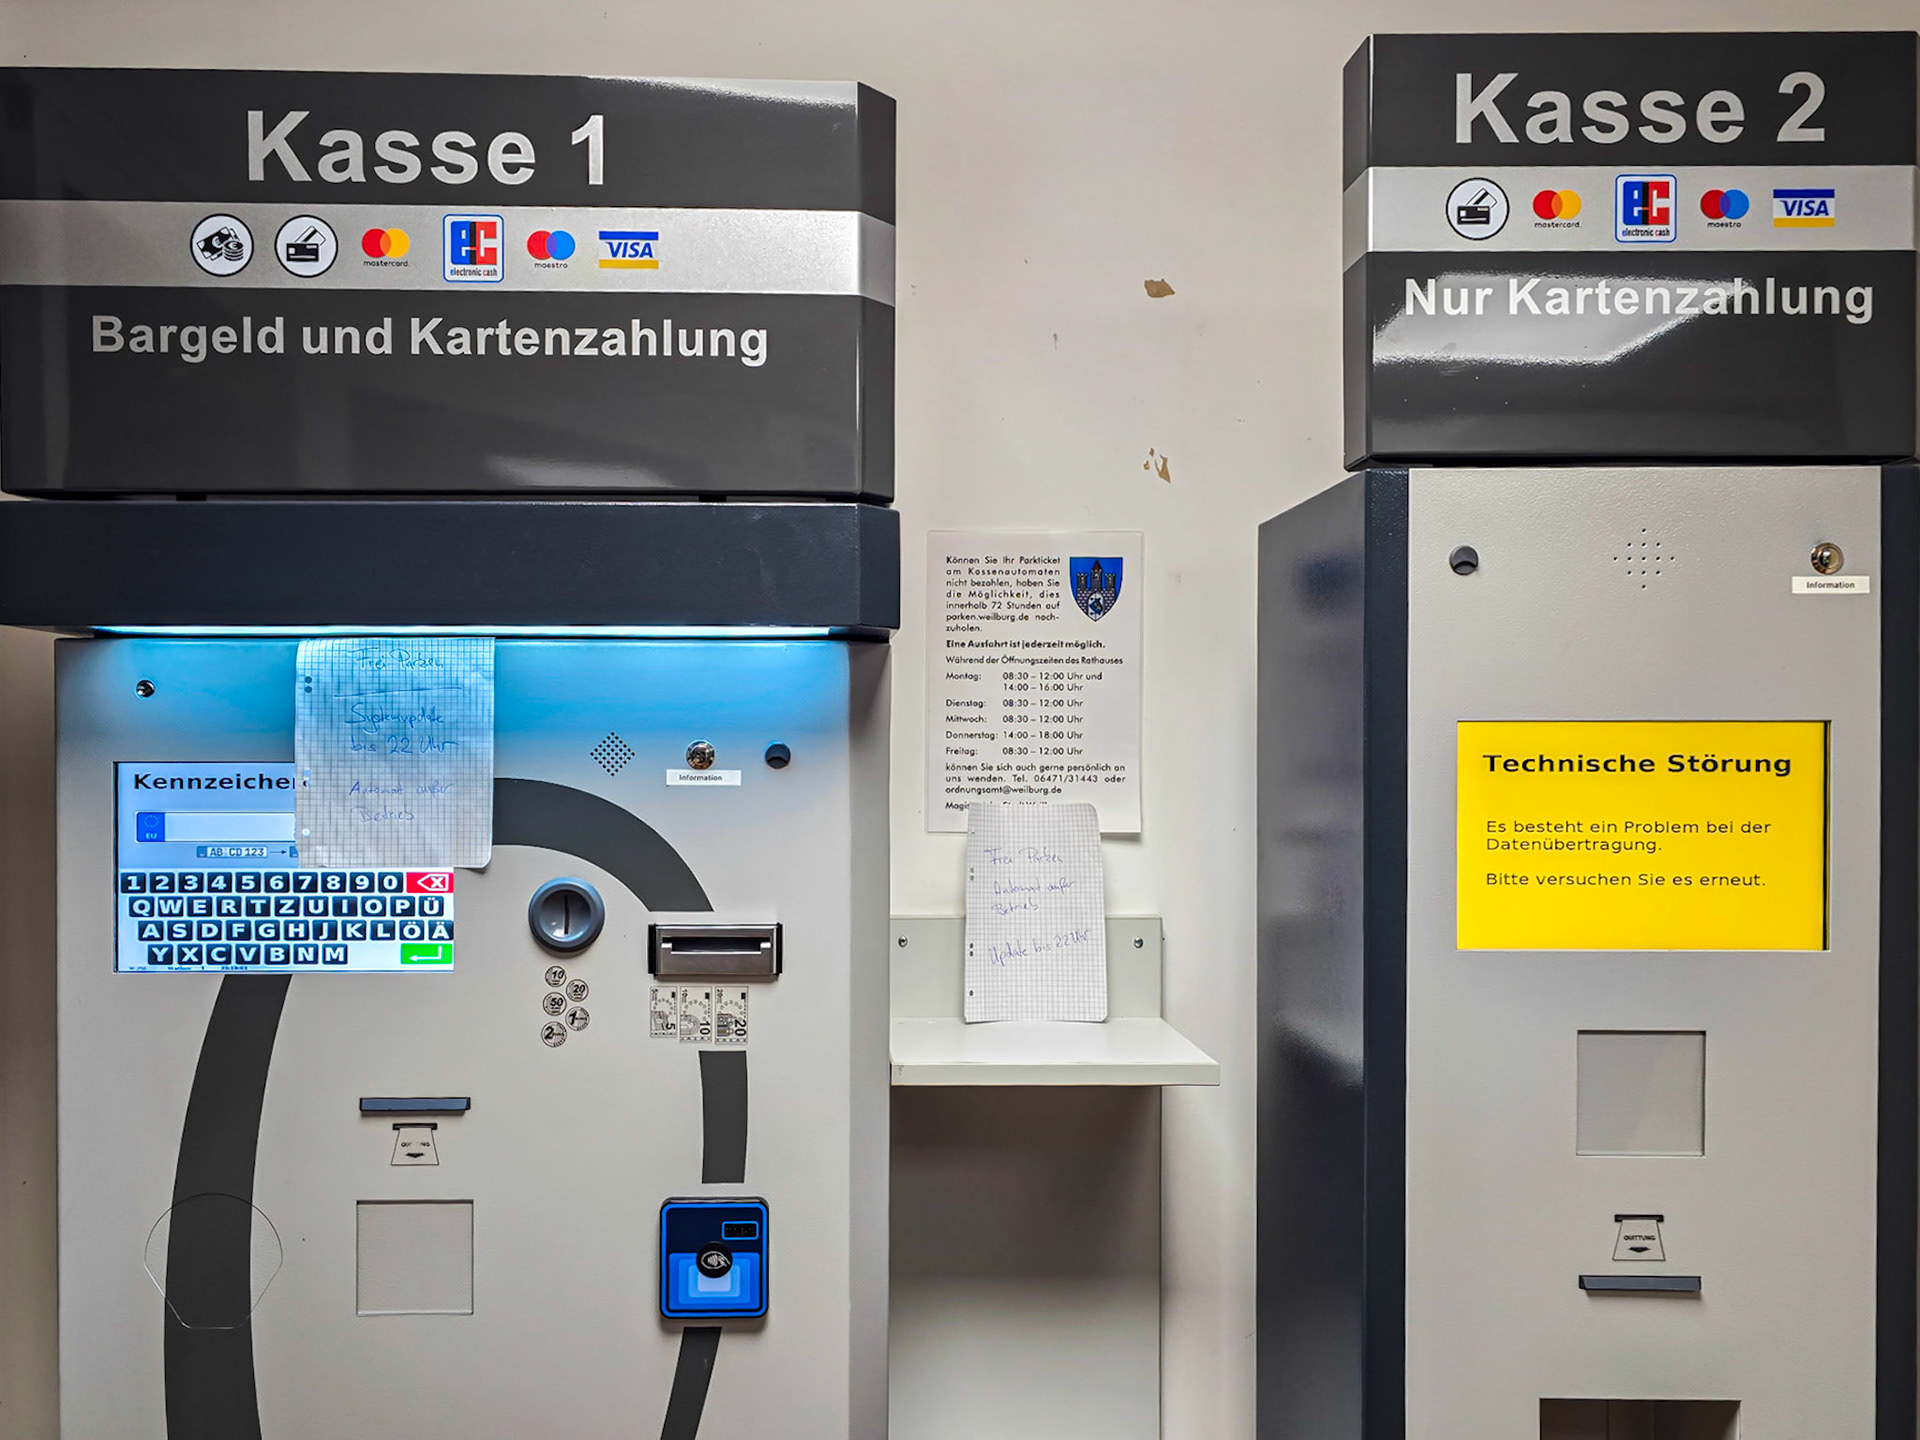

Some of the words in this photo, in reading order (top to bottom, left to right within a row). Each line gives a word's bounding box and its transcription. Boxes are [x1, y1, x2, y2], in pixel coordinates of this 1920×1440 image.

[1455, 72, 1746, 144] Kasse
[1777, 71, 1826, 143] 2
[246, 110, 537, 185] Kasse
[571, 114, 606, 186] 1
[1780, 200, 1829, 216] VISA
[1707, 220, 1741, 229] maestro
[1622, 228, 1654, 237] electronic
[1655, 228, 1670, 237] cash
[605, 242, 653, 258] VISA
[450, 267, 481, 277] electronic
[483, 268, 497, 277] cash
[1405, 278, 1492, 316] Nur
[1508, 277, 1874, 325] Kartenzahlung
[92, 314, 285, 364] Bargeld
[302, 317, 393, 356] und
[410, 317, 769, 368] Kartenzahlung
[946, 556, 979, 564] Können
[985, 556, 997, 564] Sie
[1020, 556, 1060, 564] Parkticket
[968, 567, 1060, 575] Kassenautomaten
[971, 578, 1012, 588] bezahlen,
[1016, 579, 1043, 587] haben
[1047, 579, 1060, 587] Sie
[1806, 580, 1855, 589] Information
[946, 590, 962, 598] die
[968, 590, 1032, 600] Möglichkeit,
[1039, 590, 1060, 598] dies
[946, 601, 987, 609] innerhalb
[991, 601, 1002, 609] 72
[1007, 601, 1041, 609] Stunden
[1046, 601, 1060, 609] auf
[946, 613, 1029, 622] parken.weilburg.de
[1035, 613, 1059, 621] nach-
[946, 624, 982, 632] zuholen.
[946, 640, 967, 649] Eine
[967, 640, 1008, 649] Ausfahrt
[1009, 640, 1021, 649] ist
[1022, 640, 1063, 649] jederzeit
[1065, 640, 1105, 650] möglich.
[986, 656, 999, 664] der
[1001, 655, 1064, 666] Öffnungszeiten
[1065, 656, 1079, 664] des
[1081, 656, 1123, 664] Rathauses
[945, 672, 981, 681] Montag:
[1003, 672, 1029, 680] 08:30
[1040, 672, 1064, 680] 12:00
[1067, 672, 1083, 680] Uhr
[1086, 672, 1102, 680] und
[1004, 683, 1029, 691] 14:00
[1040, 683, 1064, 691] 16:00
[1067, 683, 1083, 691] Uhr
[946, 699, 986, 708] Dienstag:
[1003, 699, 1028, 707] 08:30
[1040, 699, 1064, 707] 12:00
[1067, 699, 1083, 707] Uhr
[345, 702, 444, 734] Systemupdate
[946, 715, 987, 723] Mittwoch:
[1003, 715, 1028, 723] 08:30
[1040, 715, 1064, 723] 12:00
[946, 731, 998, 740] Donnerstag:
[1004, 731, 1028, 739] 14:00
[1039, 731, 1064, 739] 18:00
[1067, 731, 1083, 739] Uhr
[351, 736, 377, 751] bis
[387, 735, 413, 754] 22
[420, 736, 459, 753] Uhr
[946, 747, 978, 756] Freitag:
[1002, 747, 1028, 755] 08:30
[1039, 747, 1064, 755] 12:00
[1067, 747, 1083, 755] Uhr
[946, 763, 977, 771] können
[981, 763, 993, 771] Sie
[997, 763, 1013, 771] sich
[1016, 763, 1036, 771] auch
[1039, 765, 1064, 773] gerne
[1067, 763, 1111, 773] persönlich
[1483, 753, 1656, 773] Technische
[1667, 752, 1792, 777] Störung
[134, 773, 296, 790] Kennzeiche
[679, 773, 723, 783] Information
[967, 774, 1006, 782] wenden.
[1012, 774, 1027, 782] Tel.
[1034, 774, 1098, 783] 06471/31443
[945, 785, 1062, 795] ordnungsamt@weilburg.de
[1487, 820, 1507, 834] Es
[1514, 820, 1584, 834] besteht
[1590, 820, 1618, 834] ein
[1625, 820, 1699, 834] Problem
[1706, 820, 1735, 834] bei
[1740, 820, 1771, 834] der
[145, 832, 158, 840] EU
[1487, 837, 1662, 854] Datenübertragung.
[210, 848, 223, 857] AB
[229, 848, 243, 857] CD
[245, 848, 265, 857] 123
[1486, 872, 1530, 886] Bitte
[1536, 872, 1632, 887] versuchen
[1638, 872, 1666, 887] Sie
[1672, 876, 1693, 887] es
[1700, 874, 1767, 887] erneut.
[988, 941, 1028, 967] Update
[1034, 939, 1051, 952] bis
[1053, 934, 1069, 949] 22
[1070, 929, 1090, 946] Uhr
